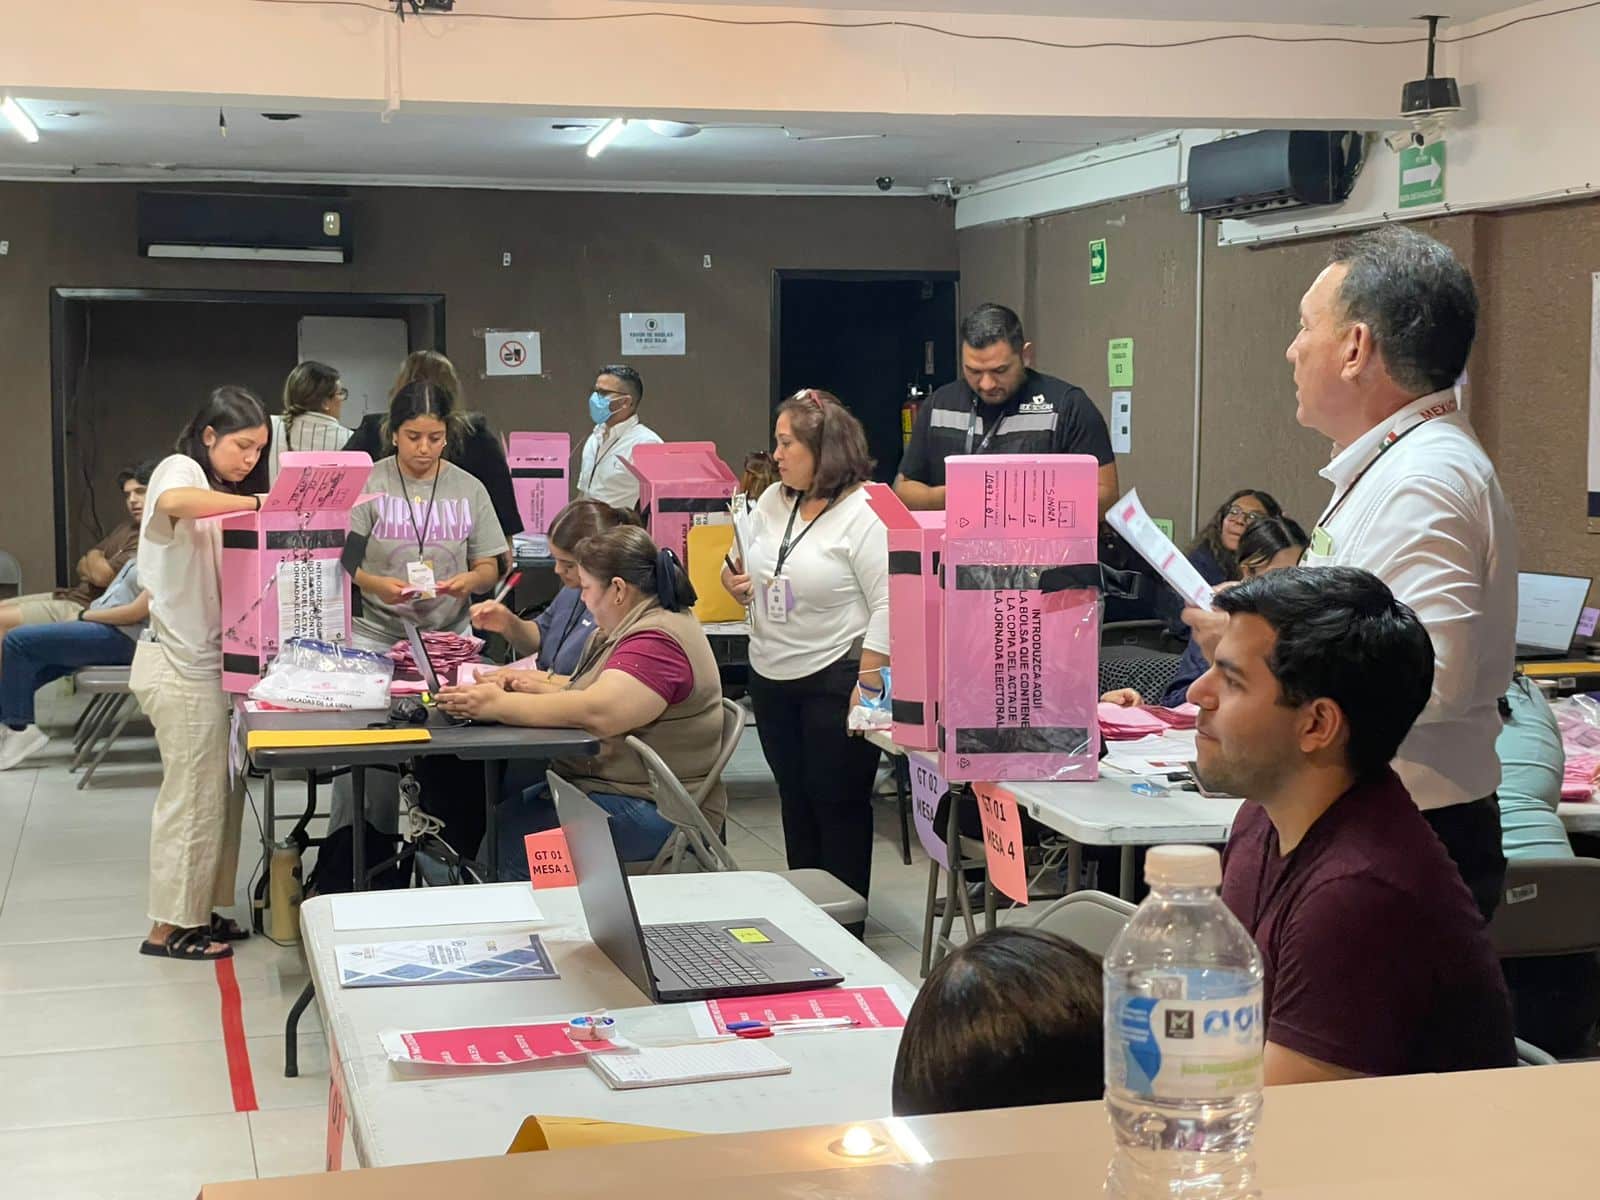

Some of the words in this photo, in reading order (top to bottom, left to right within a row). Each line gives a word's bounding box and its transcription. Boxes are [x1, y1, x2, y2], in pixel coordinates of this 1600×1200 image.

[372, 496, 473, 541] NIRVANA
[994, 591, 1003, 604] LA
[1006, 597, 1015, 611] LA
[1018, 590, 1028, 604] LA
[994, 607, 1004, 660] JORNADA
[1006, 614, 1016, 648] COPIA
[1019, 607, 1029, 643] BOLSA
[1031, 608, 1042, 679] INTRODUZCA
[1007, 651, 1017, 671] DEL
[1019, 648, 1029, 670] QUE
[995, 663, 1005, 728] ELECTORAL
[1007, 674, 1017, 703] ACTA
[1020, 672, 1030, 728] CONTIENE
[1008, 705, 1018, 721] DE
[916, 767, 928, 789] GT
[928, 773, 939, 796] 02
[981, 794, 992, 815] GT
[993, 799, 1007, 822] 01
[534, 851, 548, 861] GT
[550, 850, 563, 860] 01
[986, 827, 1006, 857] MESA
[1007, 841, 1016, 861] 4
[533, 864, 562, 875] MESA
[563, 864, 571, 873] 1
